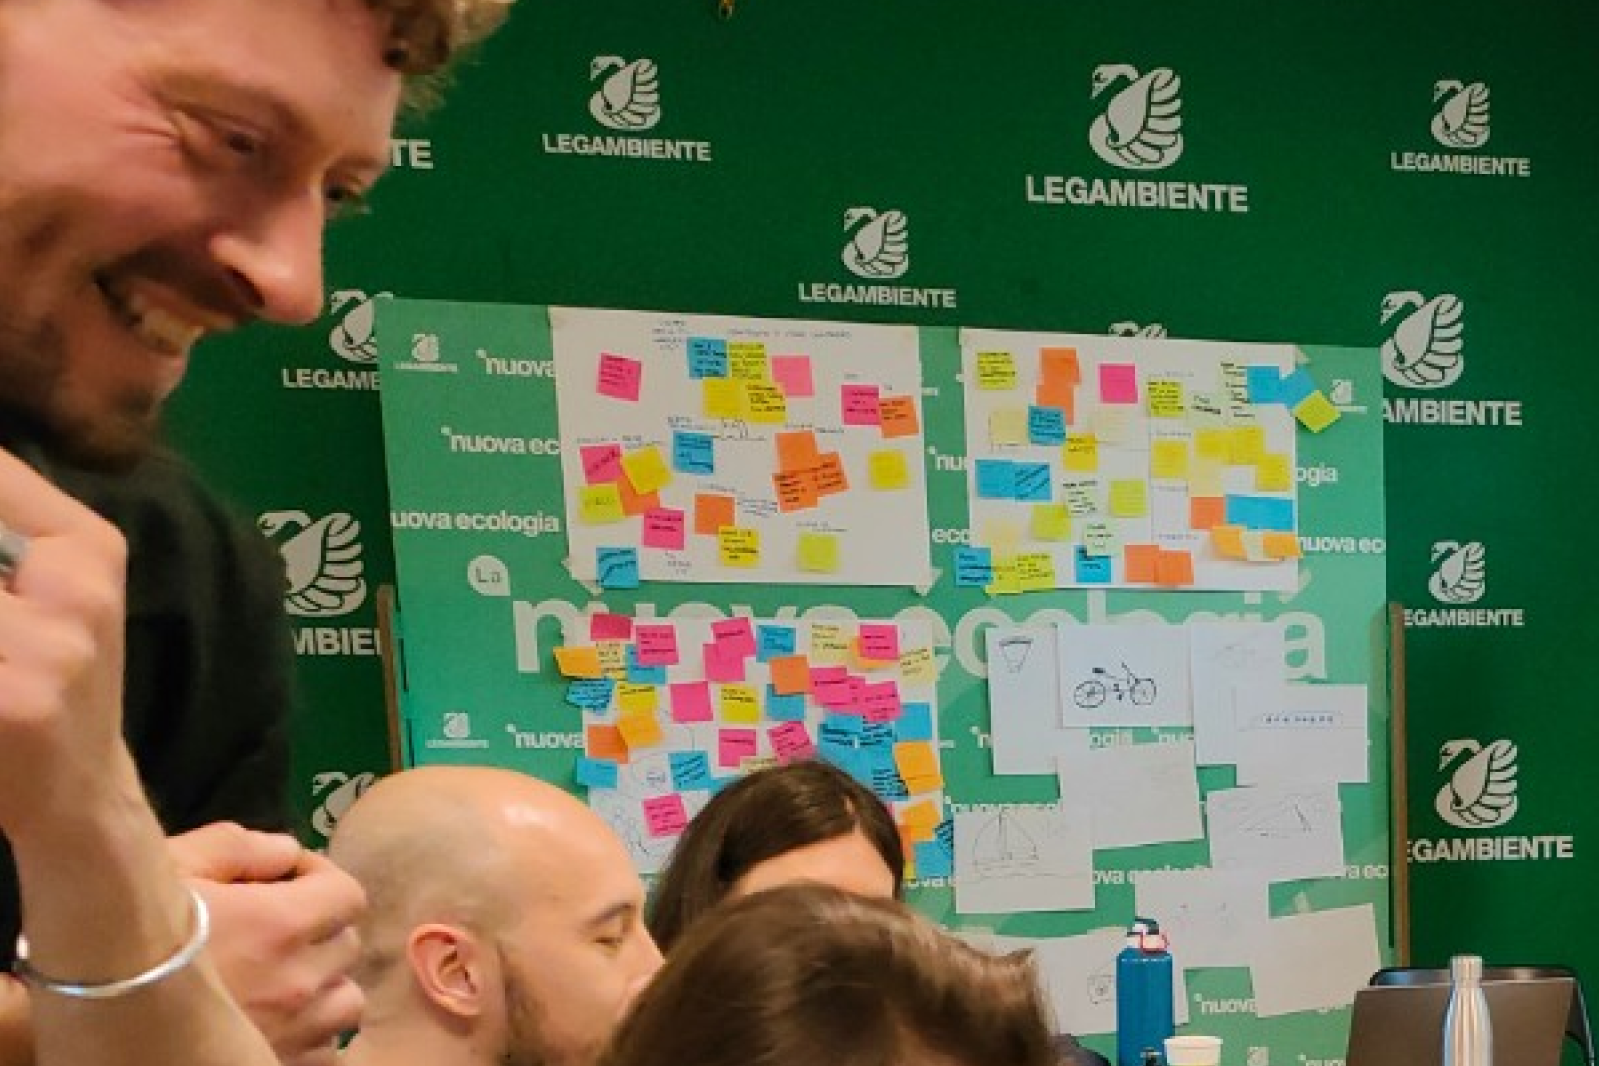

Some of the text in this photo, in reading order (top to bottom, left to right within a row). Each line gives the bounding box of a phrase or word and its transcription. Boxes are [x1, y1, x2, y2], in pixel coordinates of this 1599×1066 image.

[542, 133, 712, 163] LEGAMBIENTE
[1390, 152, 1531, 177] LEGAMBIENTE
[1025, 175, 1250, 213] LEGAMBIENTE
[797, 281, 957, 308] LEGAMBIENTE
[1383, 398, 1523, 426] AMBIENTE
[451, 434, 525, 454] nuova
[1295, 461, 1339, 487] ogia
[391, 510, 560, 538] uova ecologia
[1404, 608, 1525, 627] EGAMBIENTE
[1407, 835, 1574, 863] GAMBIENTE
